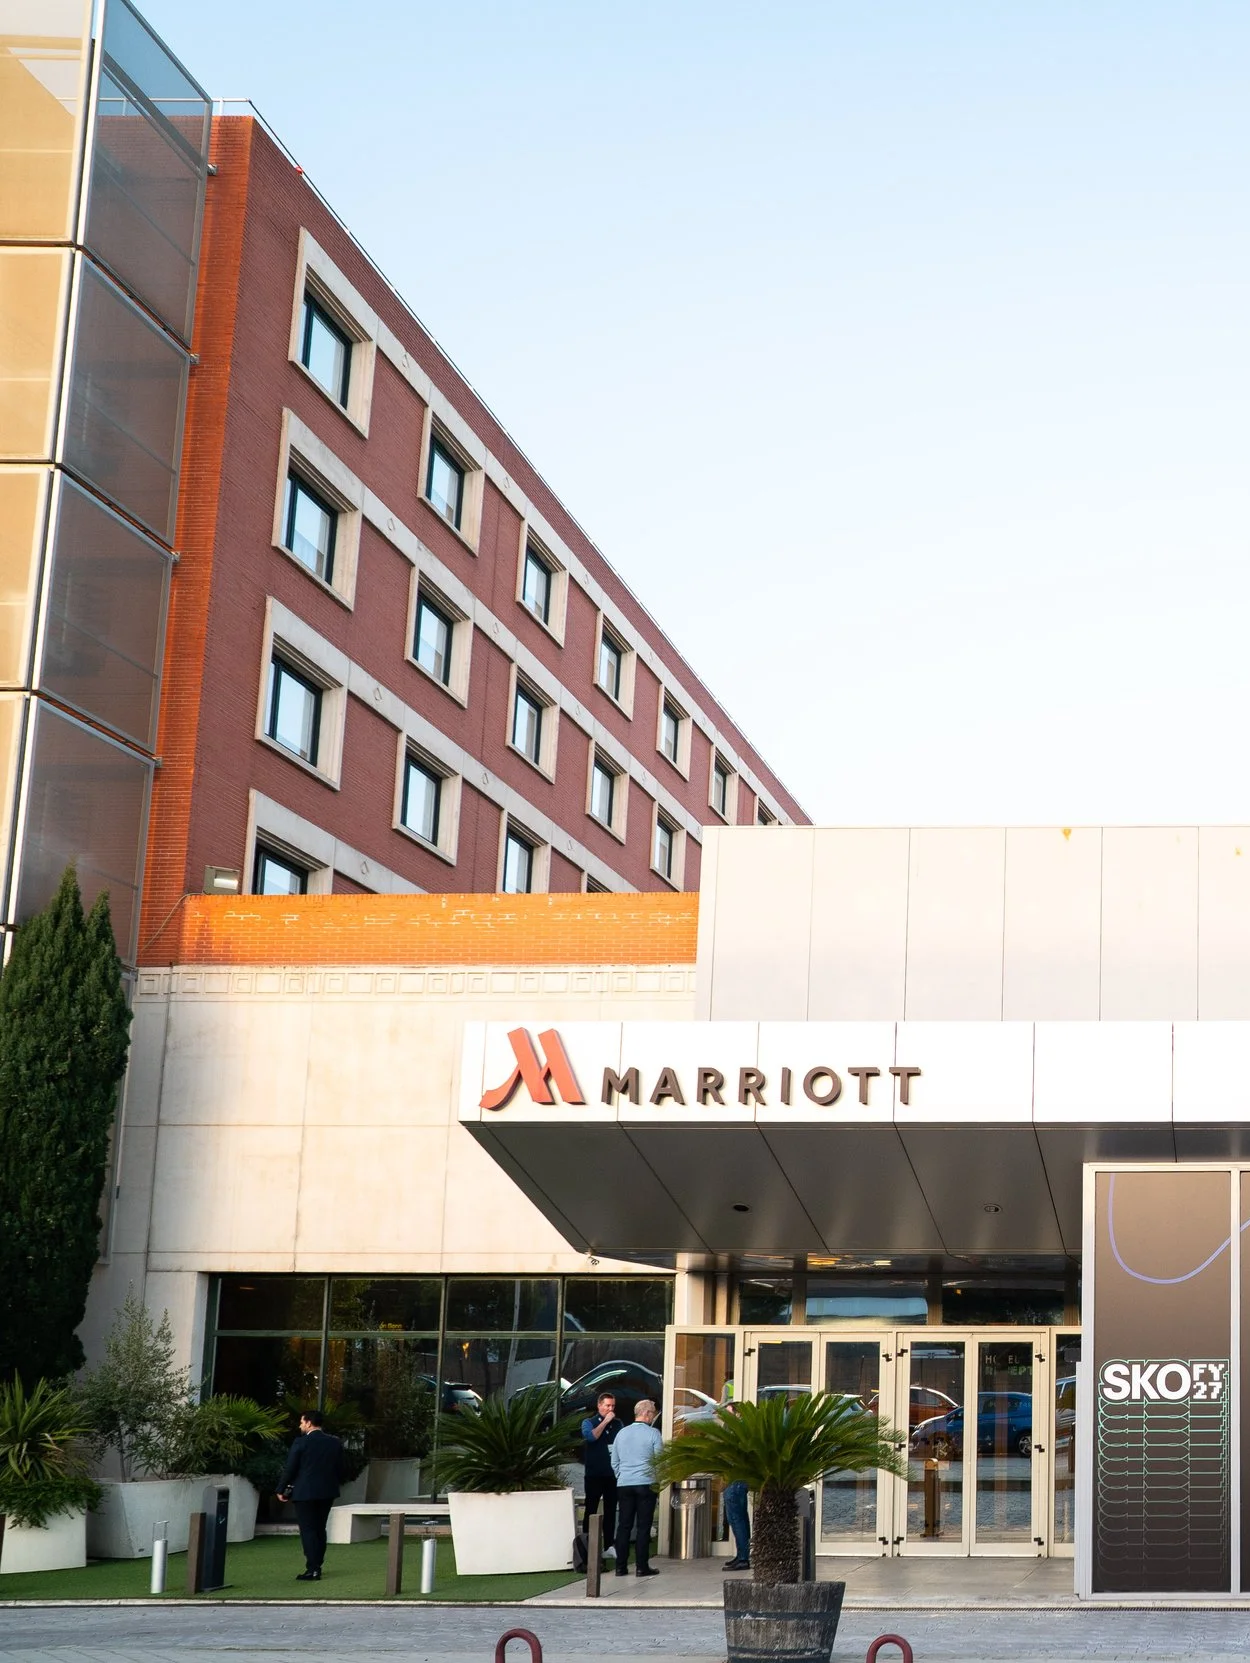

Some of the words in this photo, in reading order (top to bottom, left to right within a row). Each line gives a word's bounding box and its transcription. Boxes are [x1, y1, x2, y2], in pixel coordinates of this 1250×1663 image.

[601, 1065, 922, 1106] MARRIOTT
[1103, 1363, 1191, 1400] SKO
[1193, 1363, 1225, 1381] FY
[1193, 1381, 1223, 1399] 27
